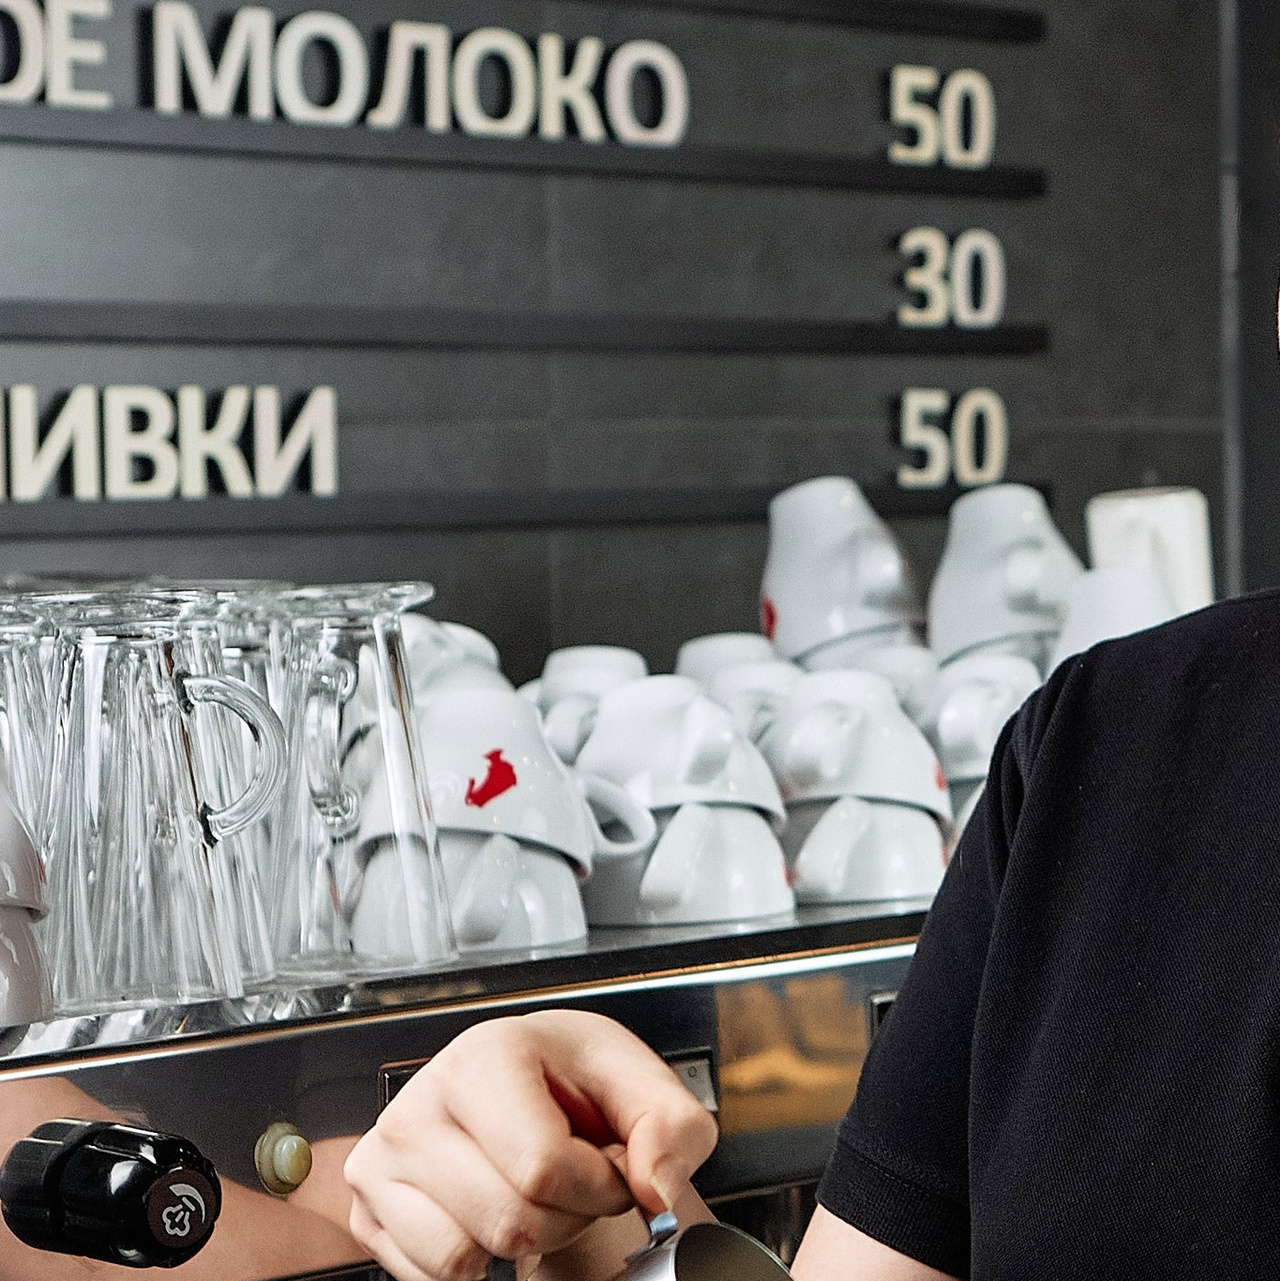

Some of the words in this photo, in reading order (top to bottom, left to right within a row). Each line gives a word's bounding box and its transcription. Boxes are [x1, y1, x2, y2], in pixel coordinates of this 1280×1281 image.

[887, 64, 996, 170] 50
[898, 226, 1005, 329] 30
[0, 383, 337, 502] ИВКИ
[898, 387, 1008, 489] 50
